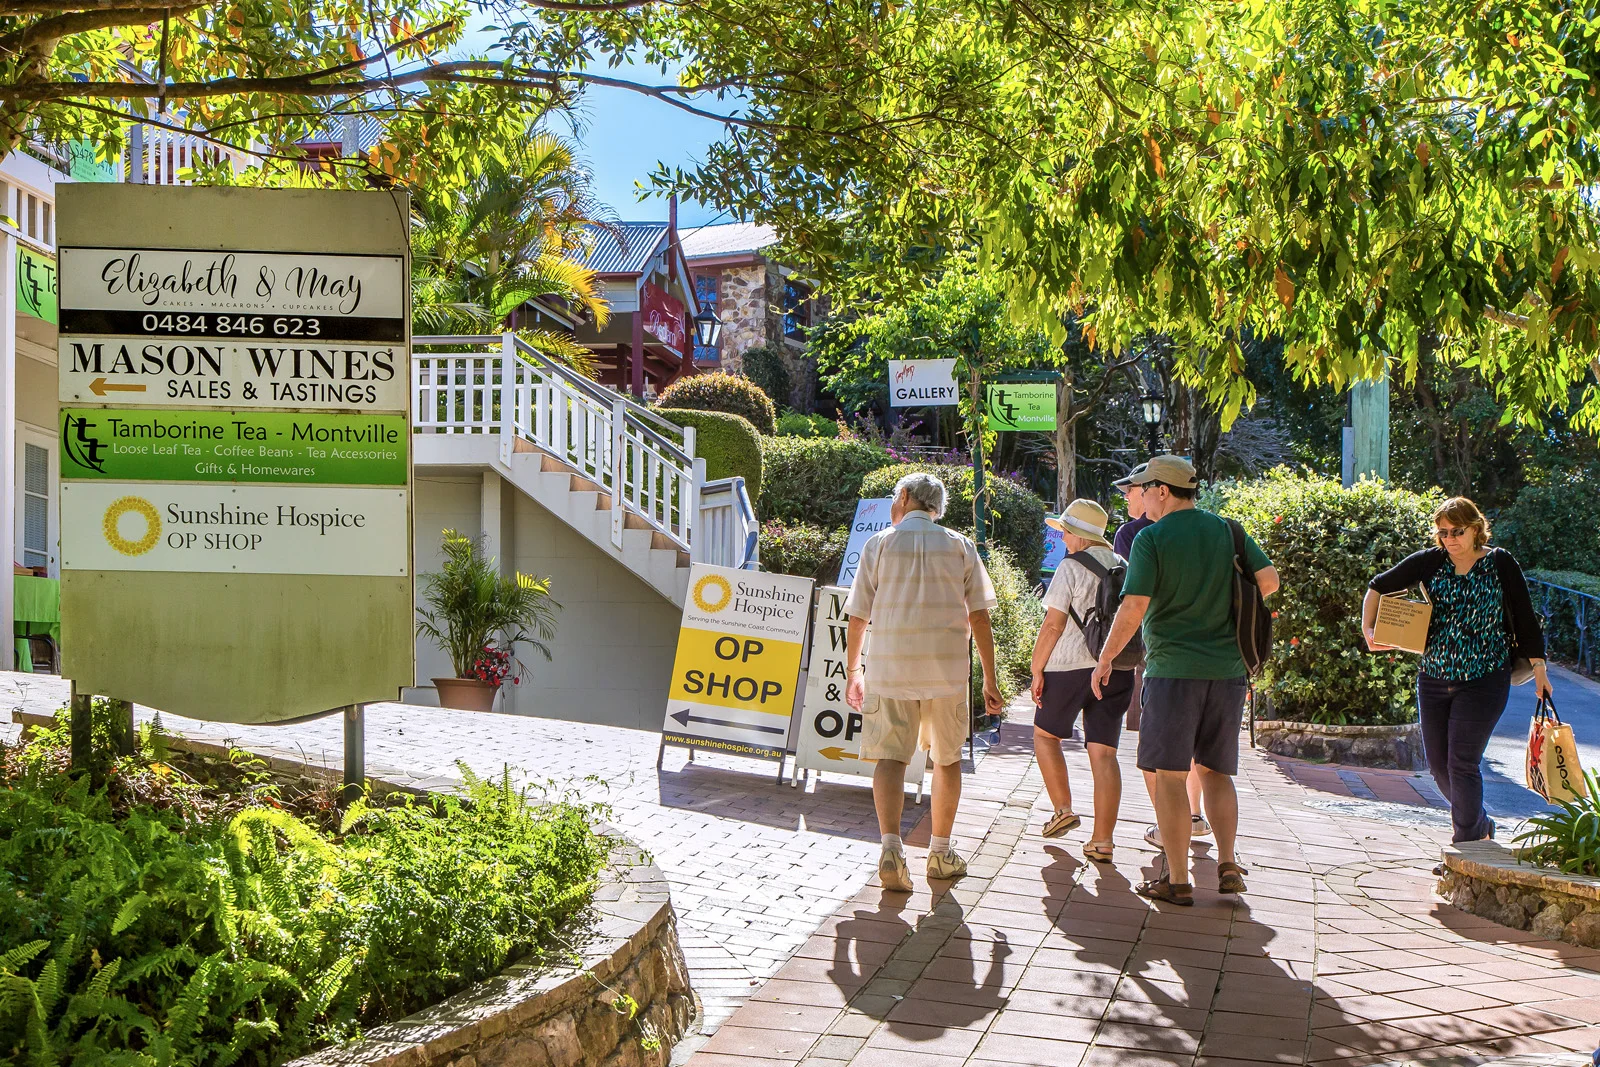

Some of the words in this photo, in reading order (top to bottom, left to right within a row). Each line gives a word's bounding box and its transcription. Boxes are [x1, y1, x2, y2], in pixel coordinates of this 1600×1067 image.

[101, 253, 237, 306] Elizabeth
[256, 265, 276, 302] &
[285, 267, 361, 315] May
[282, 303, 334, 311] CUPCAKES
[142, 314, 208, 333] 0484
[216, 316, 265, 335] 846
[273, 317, 321, 336] 623
[69, 343, 225, 377] MASON
[247, 347, 395, 381] WINES
[167, 379, 231, 400] SALES
[243, 381, 258, 400] &
[270, 382, 376, 404] TASTINGS
[896, 386, 955, 400] GALLERY
[1013, 391, 1055, 399] Tamborine
[1017, 414, 1055, 422] Montville
[1028, 403, 1041, 411] Tea
[108, 418, 225, 440] Tamborine
[232, 421, 267, 441] Tea
[291, 422, 399, 444] Montville
[113, 443, 149, 455] Loose
[153, 443, 178, 455] Leaf
[181, 444, 202, 456] Tea
[214, 444, 255, 457] Coffee
[259, 446, 294, 458] Beans
[306, 447, 326, 459] Tea
[331, 447, 397, 460] Accessories
[195, 462, 223, 475] Gifts
[227, 463, 237, 475] &
[241, 463, 316, 476] Homewares
[167, 502, 268, 527] Sunshine
[276, 505, 366, 535] Hospice
[855, 522, 891, 532] GALLE
[167, 532, 198, 550] OP
[204, 533, 263, 551] SHOP
[735, 581, 805, 605] Sunshine
[733, 598, 794, 621] Hospice
[687, 615, 709, 624] Serving
[710, 617, 721, 625] the
[721, 619, 747, 629] Sunshine
[748, 623, 765, 631] Coast
[766, 626, 800, 637] Community
[714, 636, 765, 663] OP
[683, 669, 783, 704] SHOP
[825, 683, 841, 702] &
[814, 709, 863, 742] OP
[664, 734, 782, 758] www.sunshinehospice.org.au
